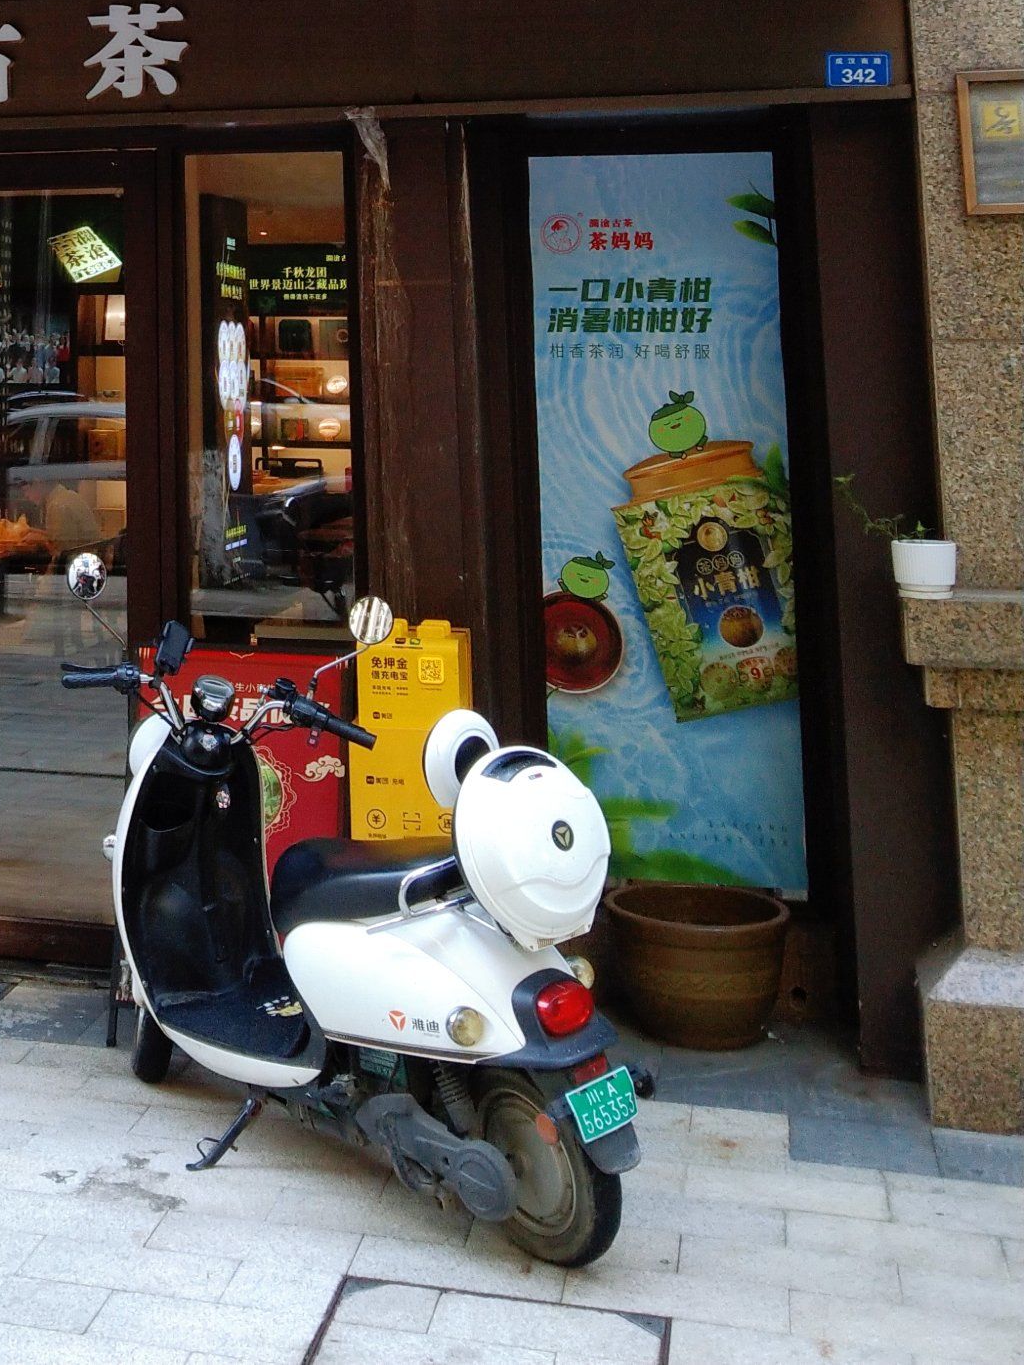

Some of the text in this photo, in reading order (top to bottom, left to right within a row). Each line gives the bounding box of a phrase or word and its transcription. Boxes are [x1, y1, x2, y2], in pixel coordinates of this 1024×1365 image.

[841, 68, 876, 84] 342
[588, 231, 655, 251] 茶妈妈
[548, 277, 712, 304] 一口小青柑
[547, 307, 713, 334] 消暑柑柑好
[549, 343, 711, 359] 柑香茶润 好喝舒服
[371, 656, 409, 670] 免押金
[371, 670, 409, 681] 借充电宝
[411, 1018, 440, 1034] 雅迪
[582, 1092, 635, 1134] 565353
